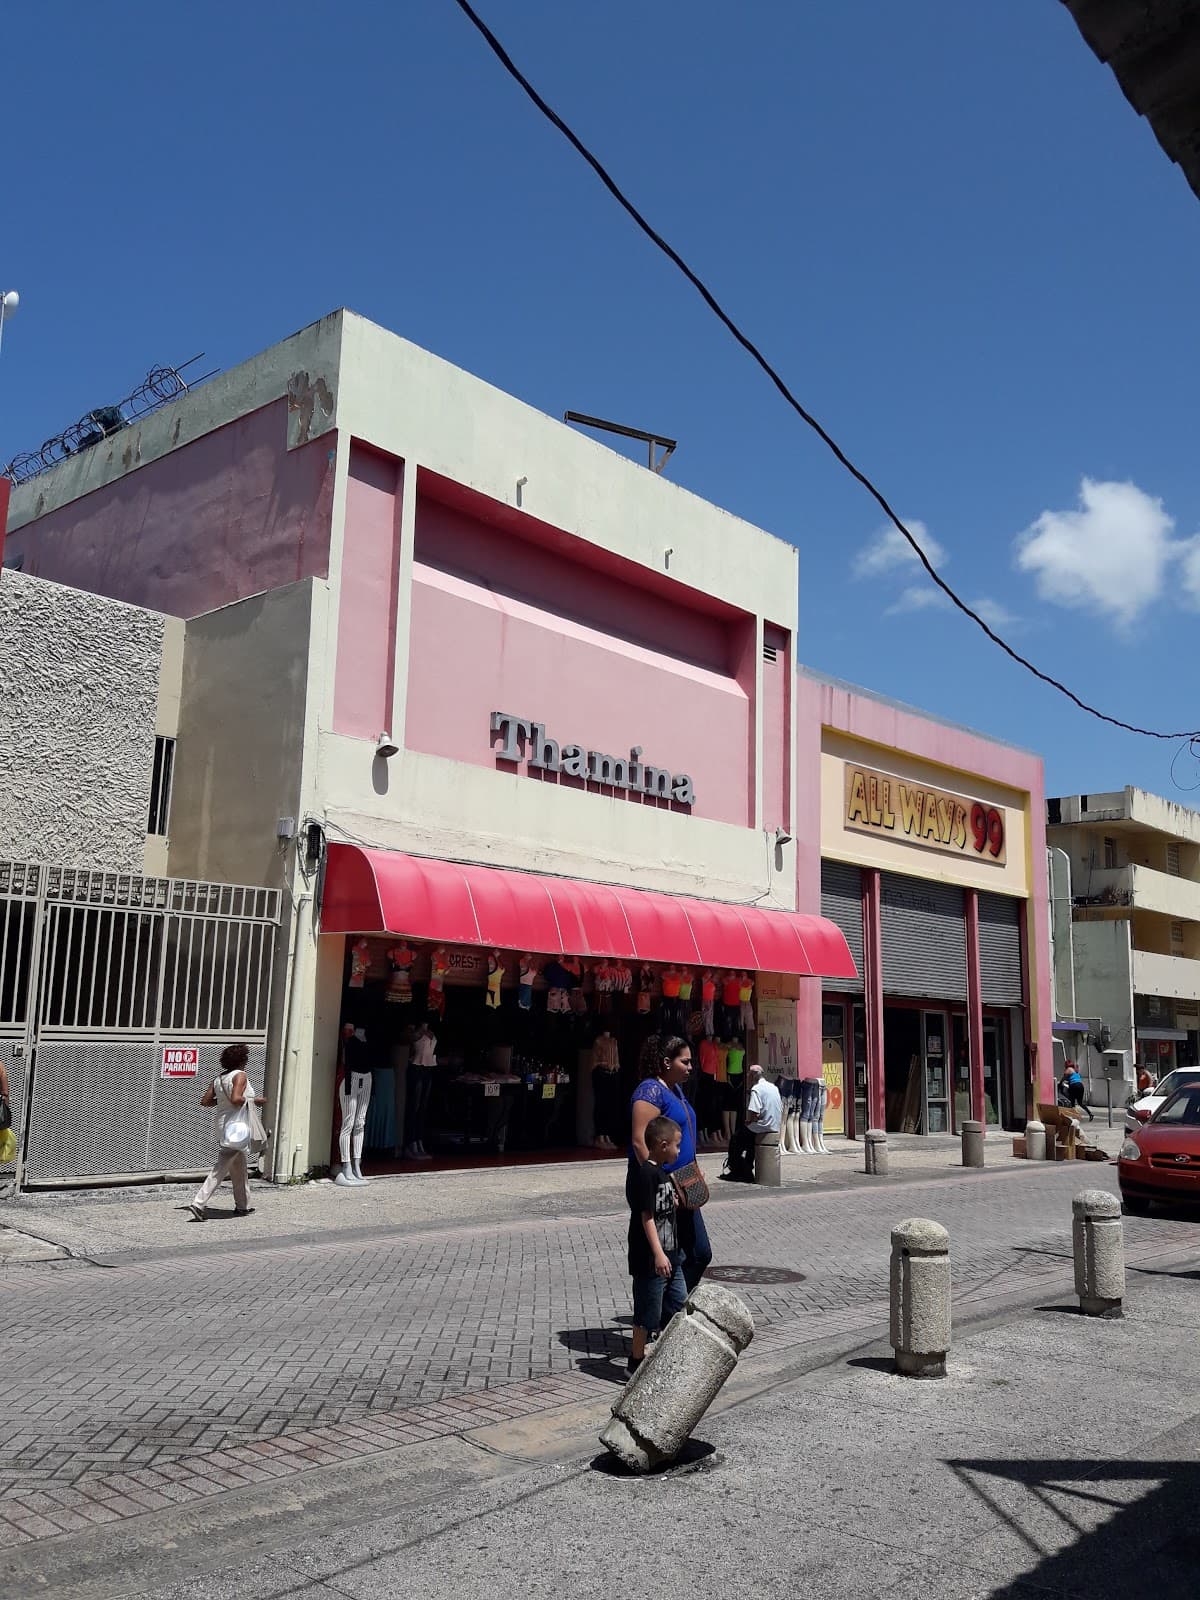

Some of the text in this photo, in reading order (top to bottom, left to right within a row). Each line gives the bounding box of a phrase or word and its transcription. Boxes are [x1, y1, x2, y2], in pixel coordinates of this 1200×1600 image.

[490, 711, 696, 805] Thamina
[848, 771, 1003, 858] ALL WAYS 99
[164, 1062, 196, 1072] PARKING
[167, 1051, 183, 1063] NO
